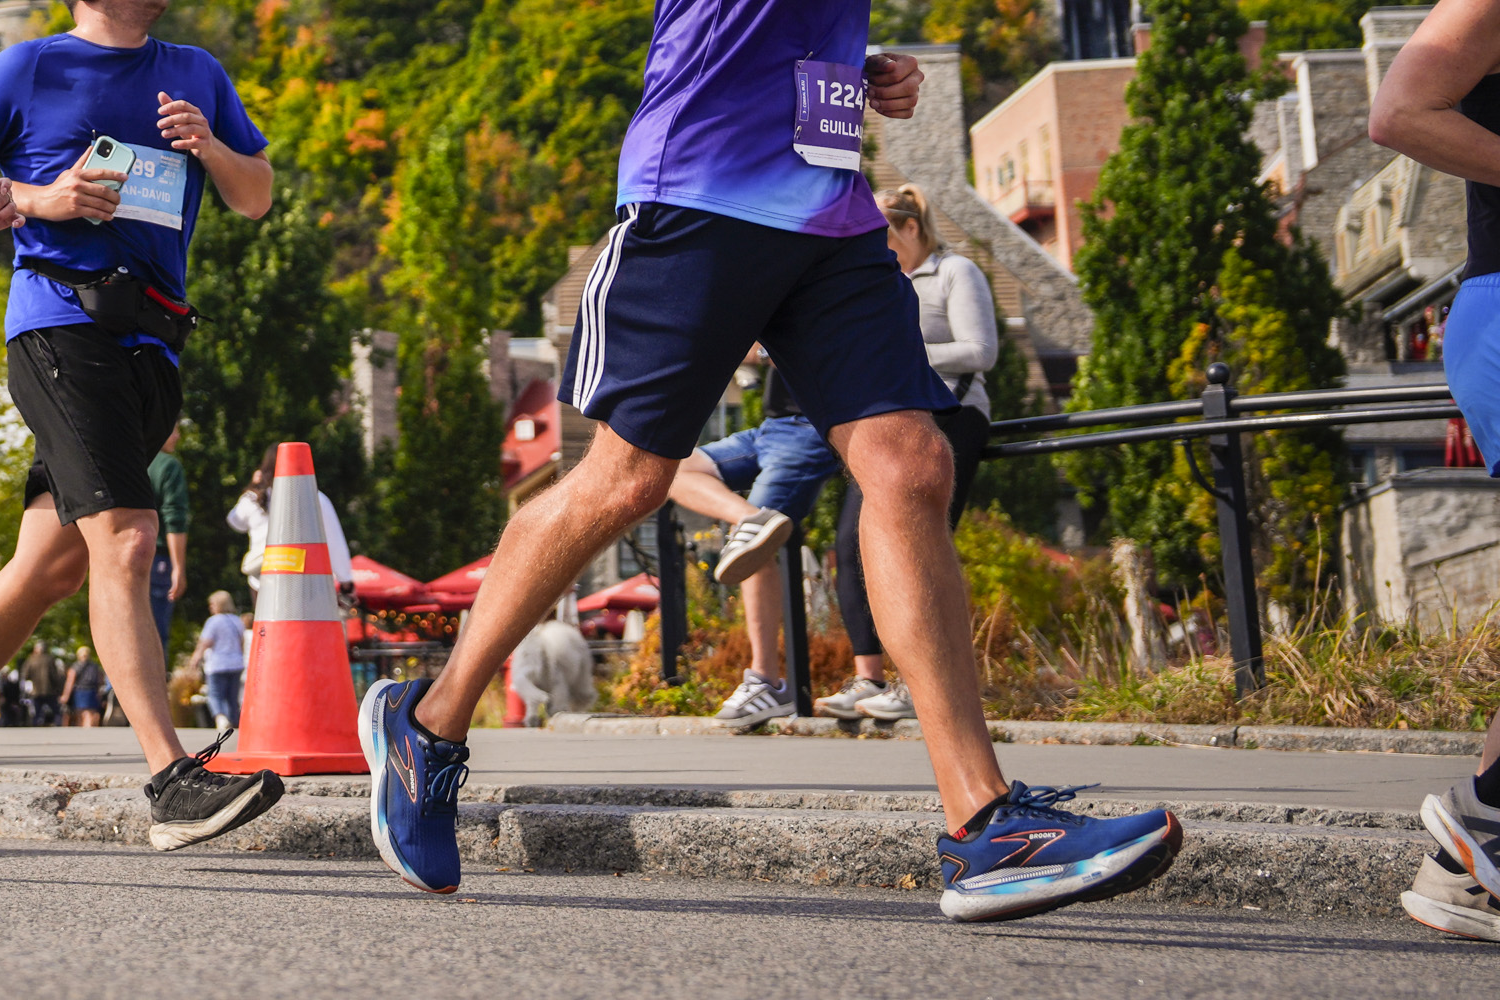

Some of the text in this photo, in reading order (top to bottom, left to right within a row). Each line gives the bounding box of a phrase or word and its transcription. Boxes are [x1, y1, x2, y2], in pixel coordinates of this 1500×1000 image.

[816, 79, 864, 111] 1224
[819, 118, 863, 139] GUILLA
[131, 158, 156, 178] 89
[119, 184, 171, 203] AN-DAVID
[1028, 831, 1057, 841] BROOKS
